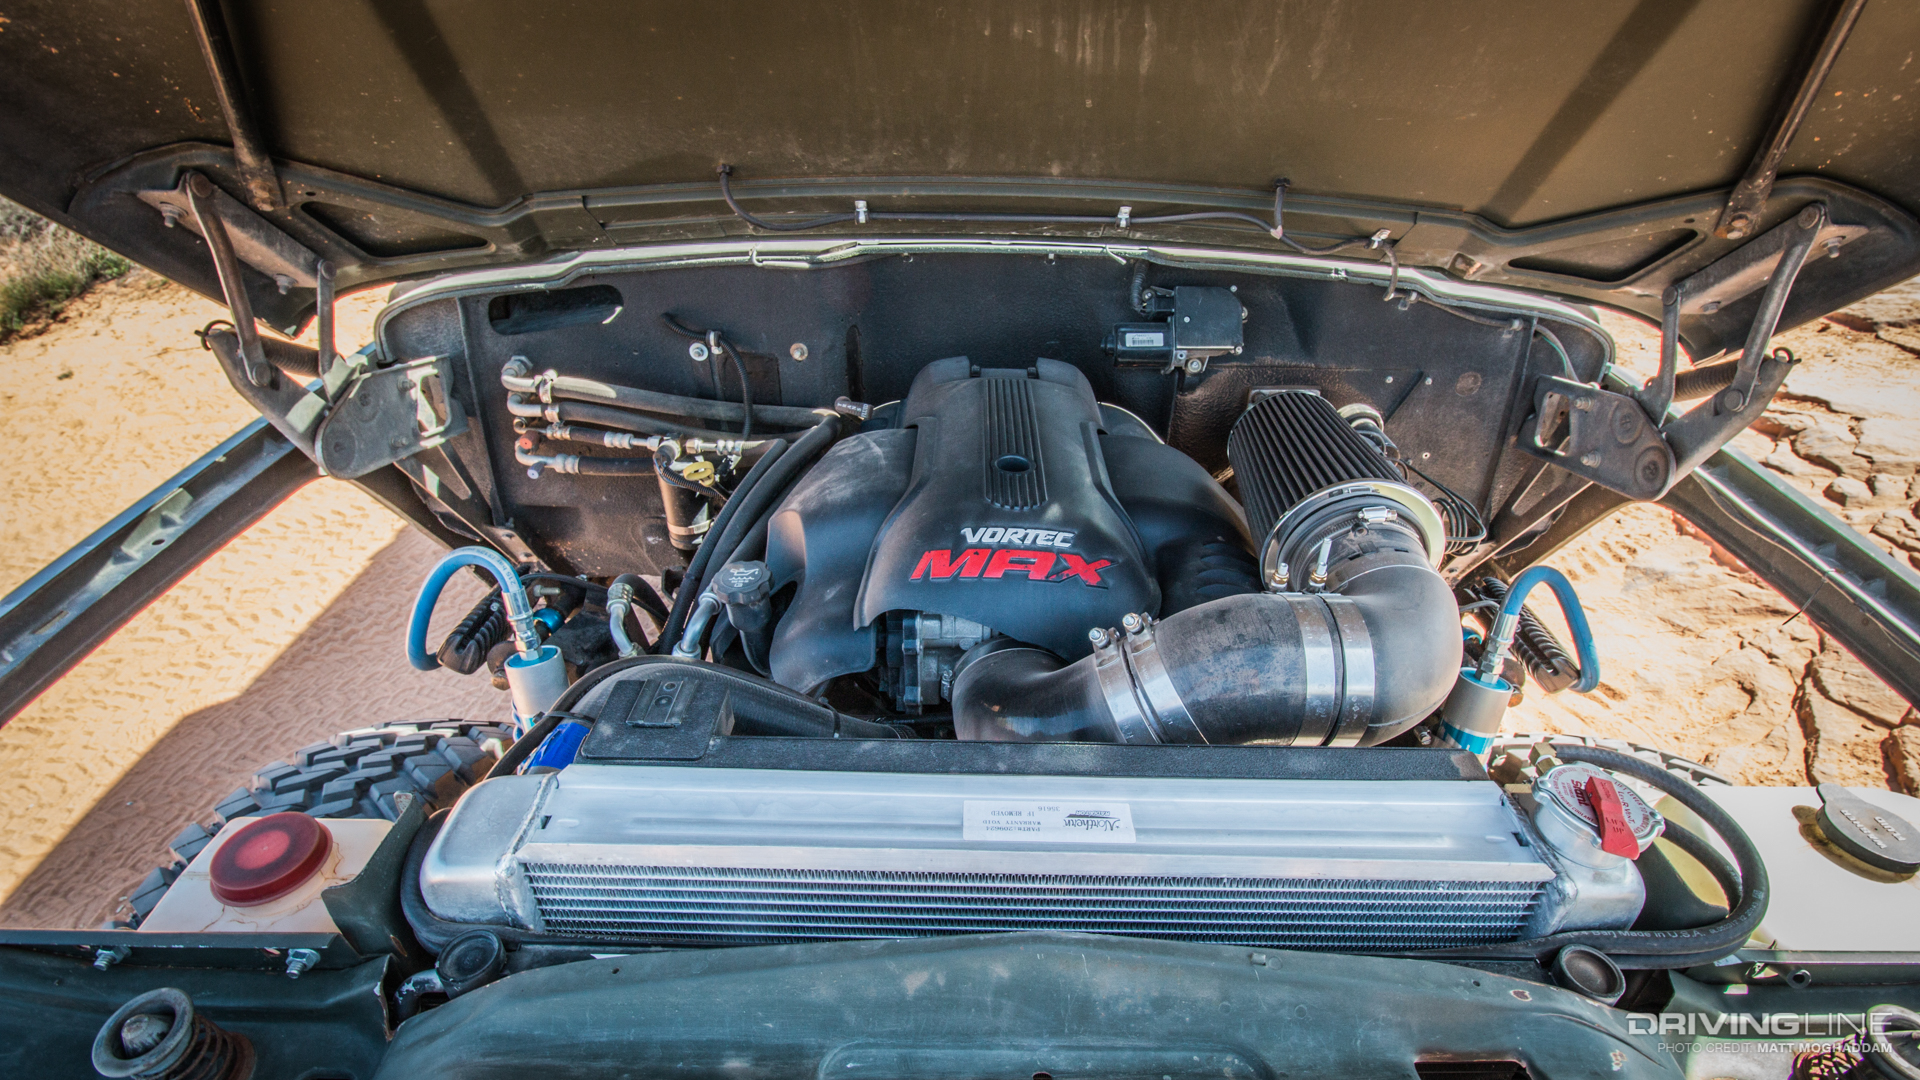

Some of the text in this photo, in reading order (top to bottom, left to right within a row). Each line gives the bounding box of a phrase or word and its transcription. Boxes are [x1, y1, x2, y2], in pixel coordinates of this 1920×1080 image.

[837, 402, 862, 412] TRANS
[961, 527, 1076, 548] VORTEC
[909, 548, 1119, 589] MAX
[1571, 779, 1590, 806] Stant
[1063, 818, 1121, 832] Northern
[1840, 809, 1888, 849] WASHER
[1873, 816, 1906, 841] FLUID
